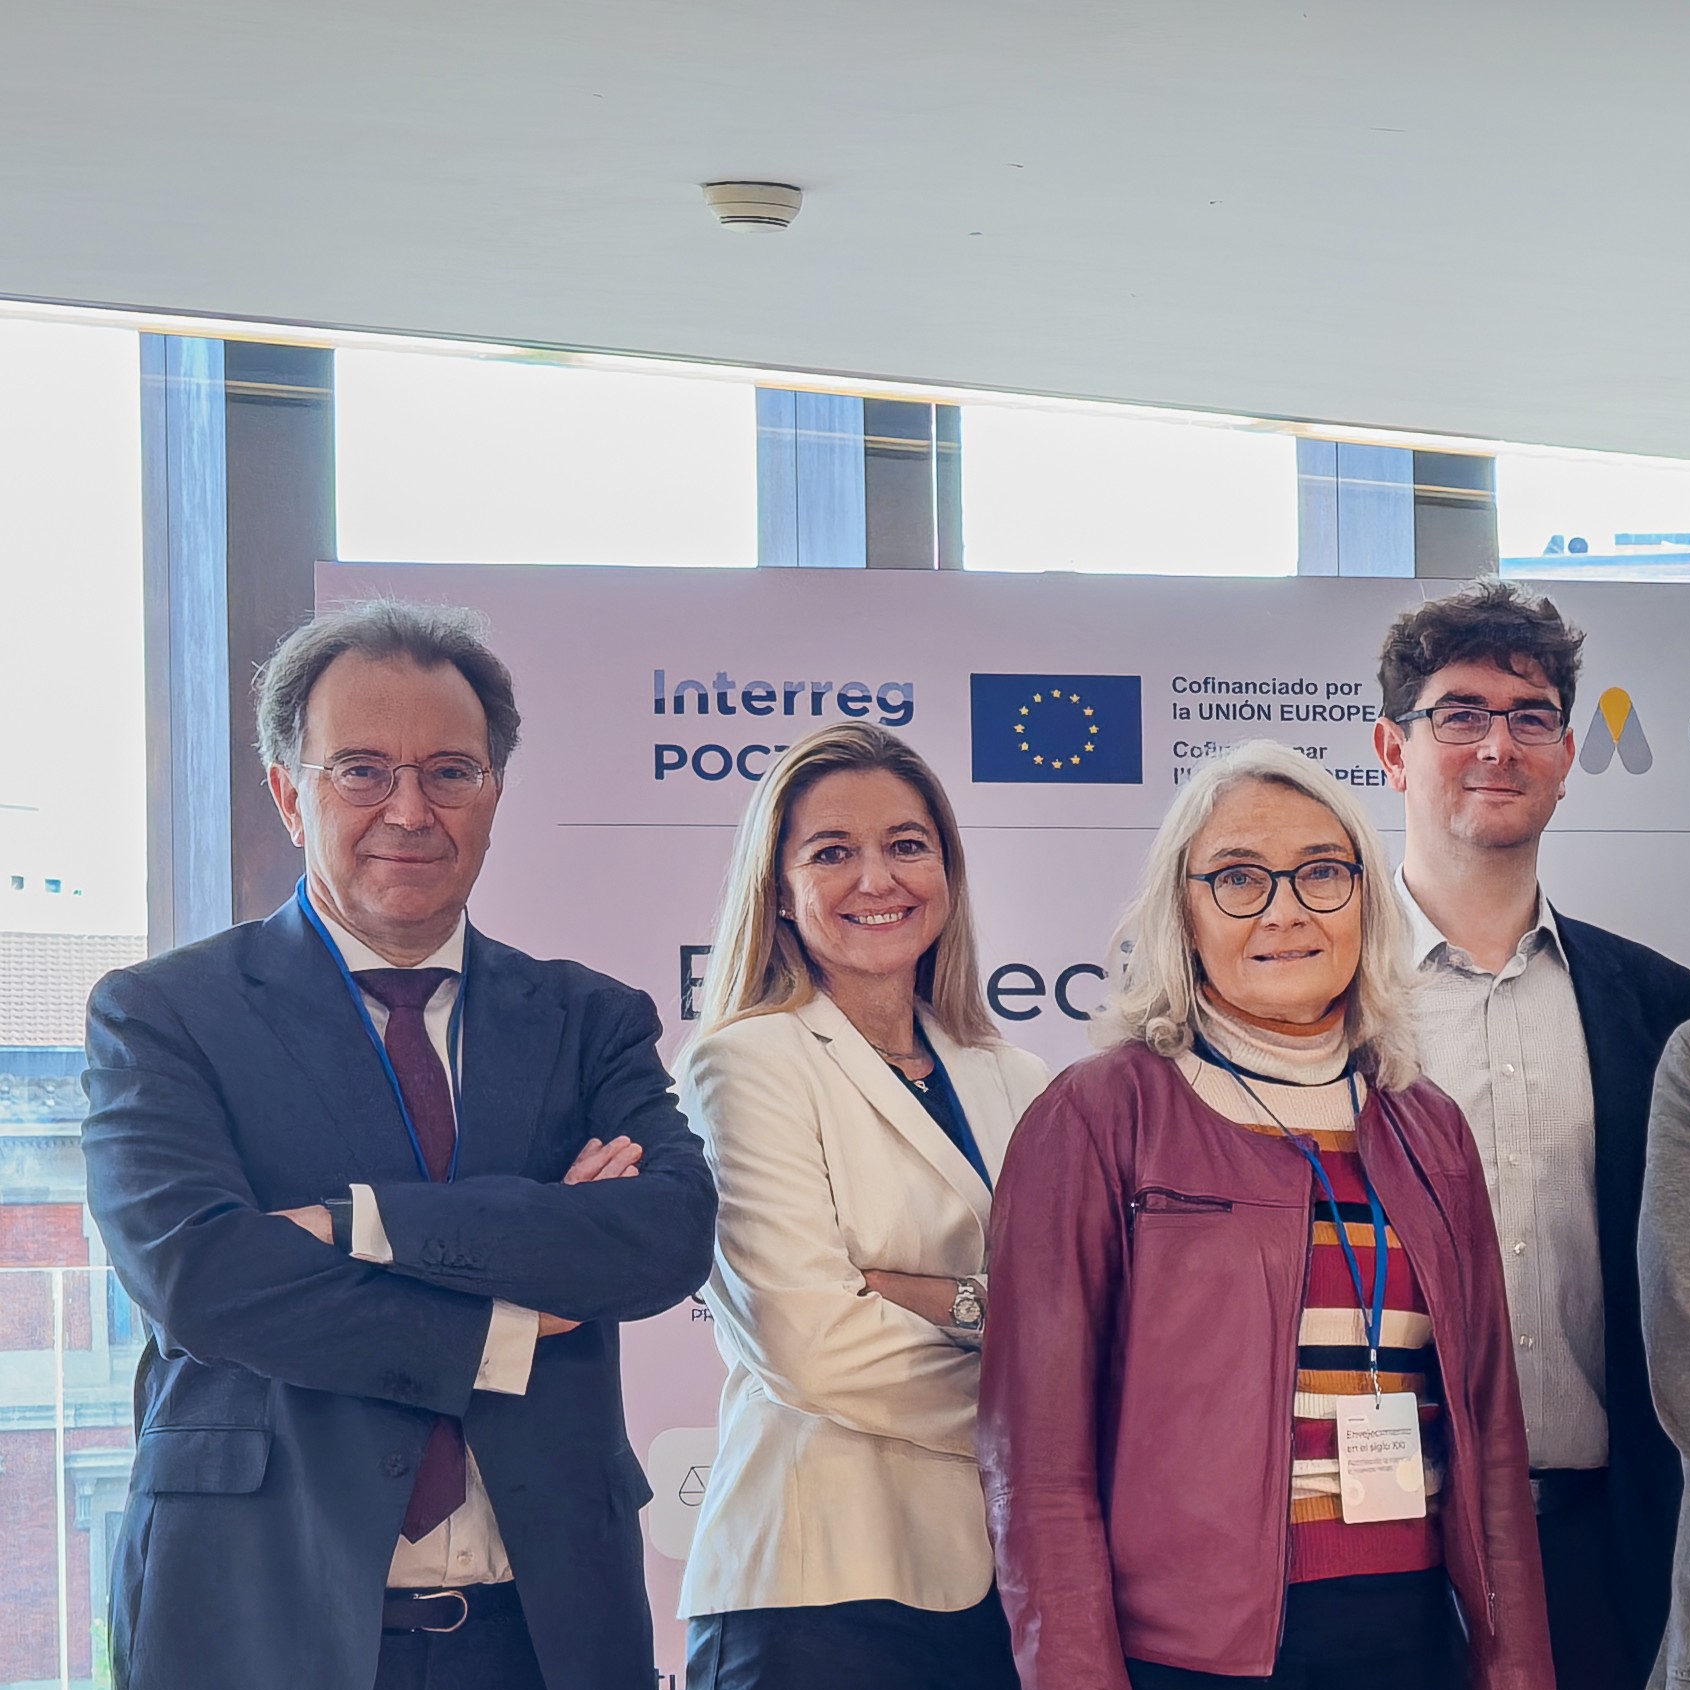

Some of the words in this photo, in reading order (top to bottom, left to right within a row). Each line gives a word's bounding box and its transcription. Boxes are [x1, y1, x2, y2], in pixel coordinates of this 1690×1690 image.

[654, 669, 914, 726] Interreg
[1172, 676, 1318, 695] Cofinanciado
[1326, 682, 1362, 699] por
[1172, 703, 1191, 721] la
[1199, 700, 1272, 721] UNIÓN
[654, 744, 791, 781] POC
